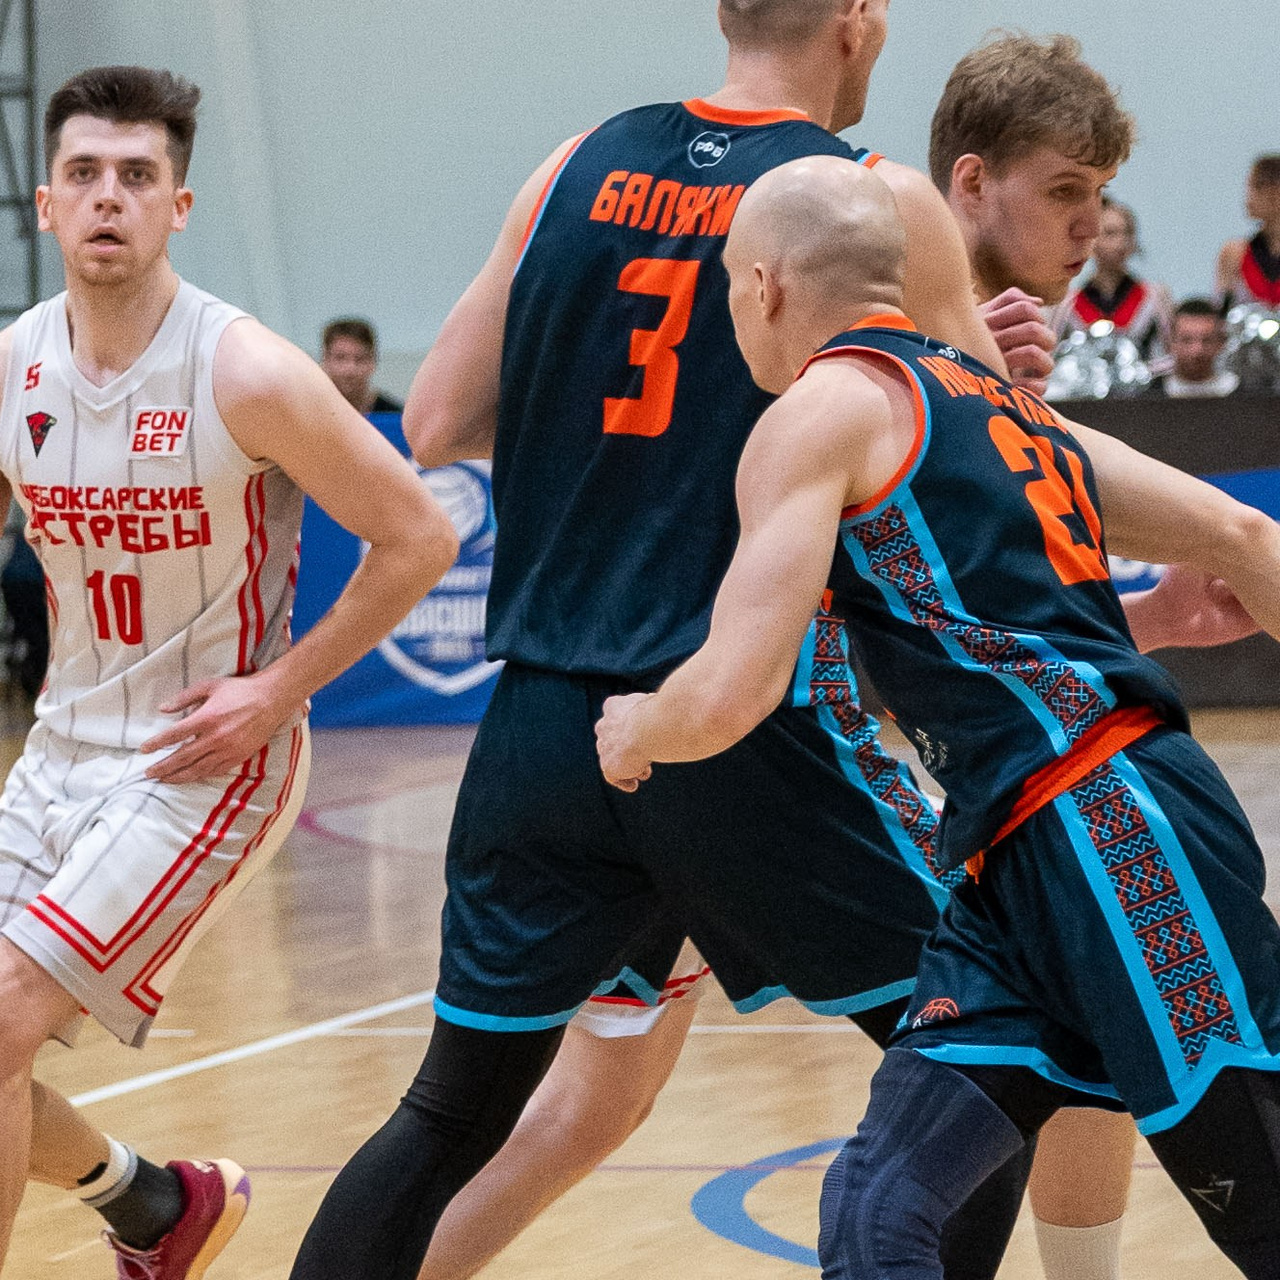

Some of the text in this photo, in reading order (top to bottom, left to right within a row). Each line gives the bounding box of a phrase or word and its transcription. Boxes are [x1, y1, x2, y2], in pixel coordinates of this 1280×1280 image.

[693, 141, 725, 158] РФБ
[602, 257, 701, 438] 3
[135, 410, 188, 431] FON
[131, 433, 183, 452] BET
[86, 569, 144, 646] 10
